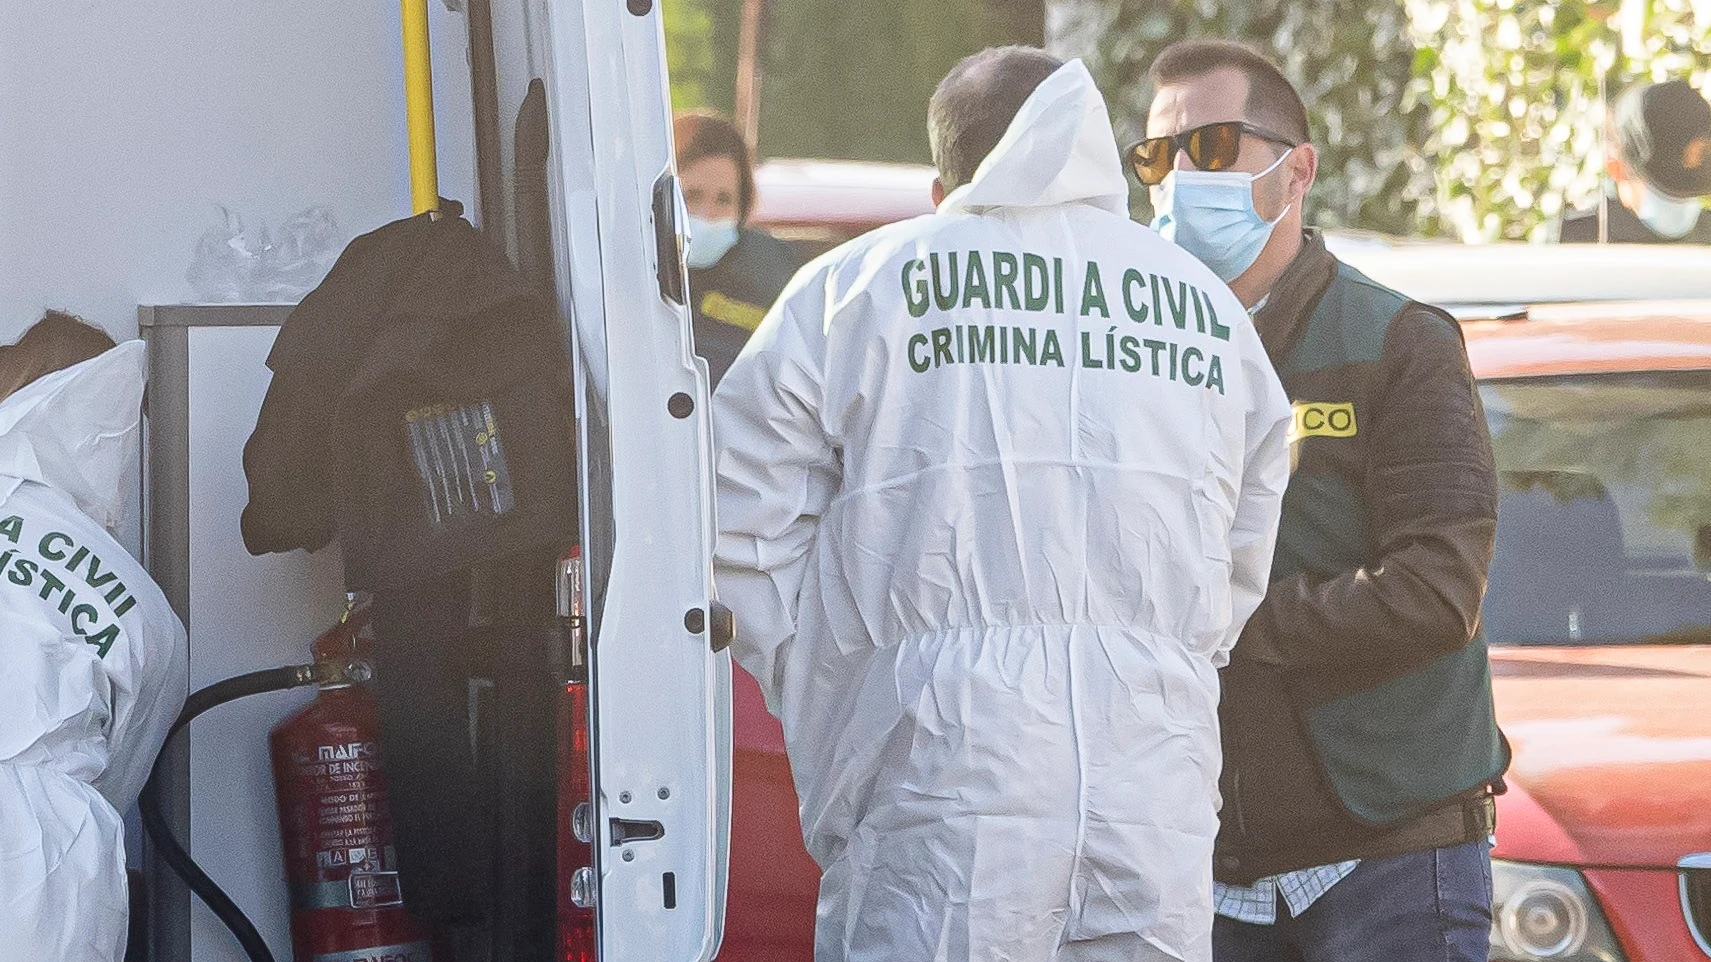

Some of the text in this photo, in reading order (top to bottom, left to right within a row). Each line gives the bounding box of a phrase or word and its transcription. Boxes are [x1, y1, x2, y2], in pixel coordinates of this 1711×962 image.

[1121, 268, 1232, 342] CIVIL
[38, 531, 138, 619] CIVIL
[318, 742, 377, 761] MAIFO
